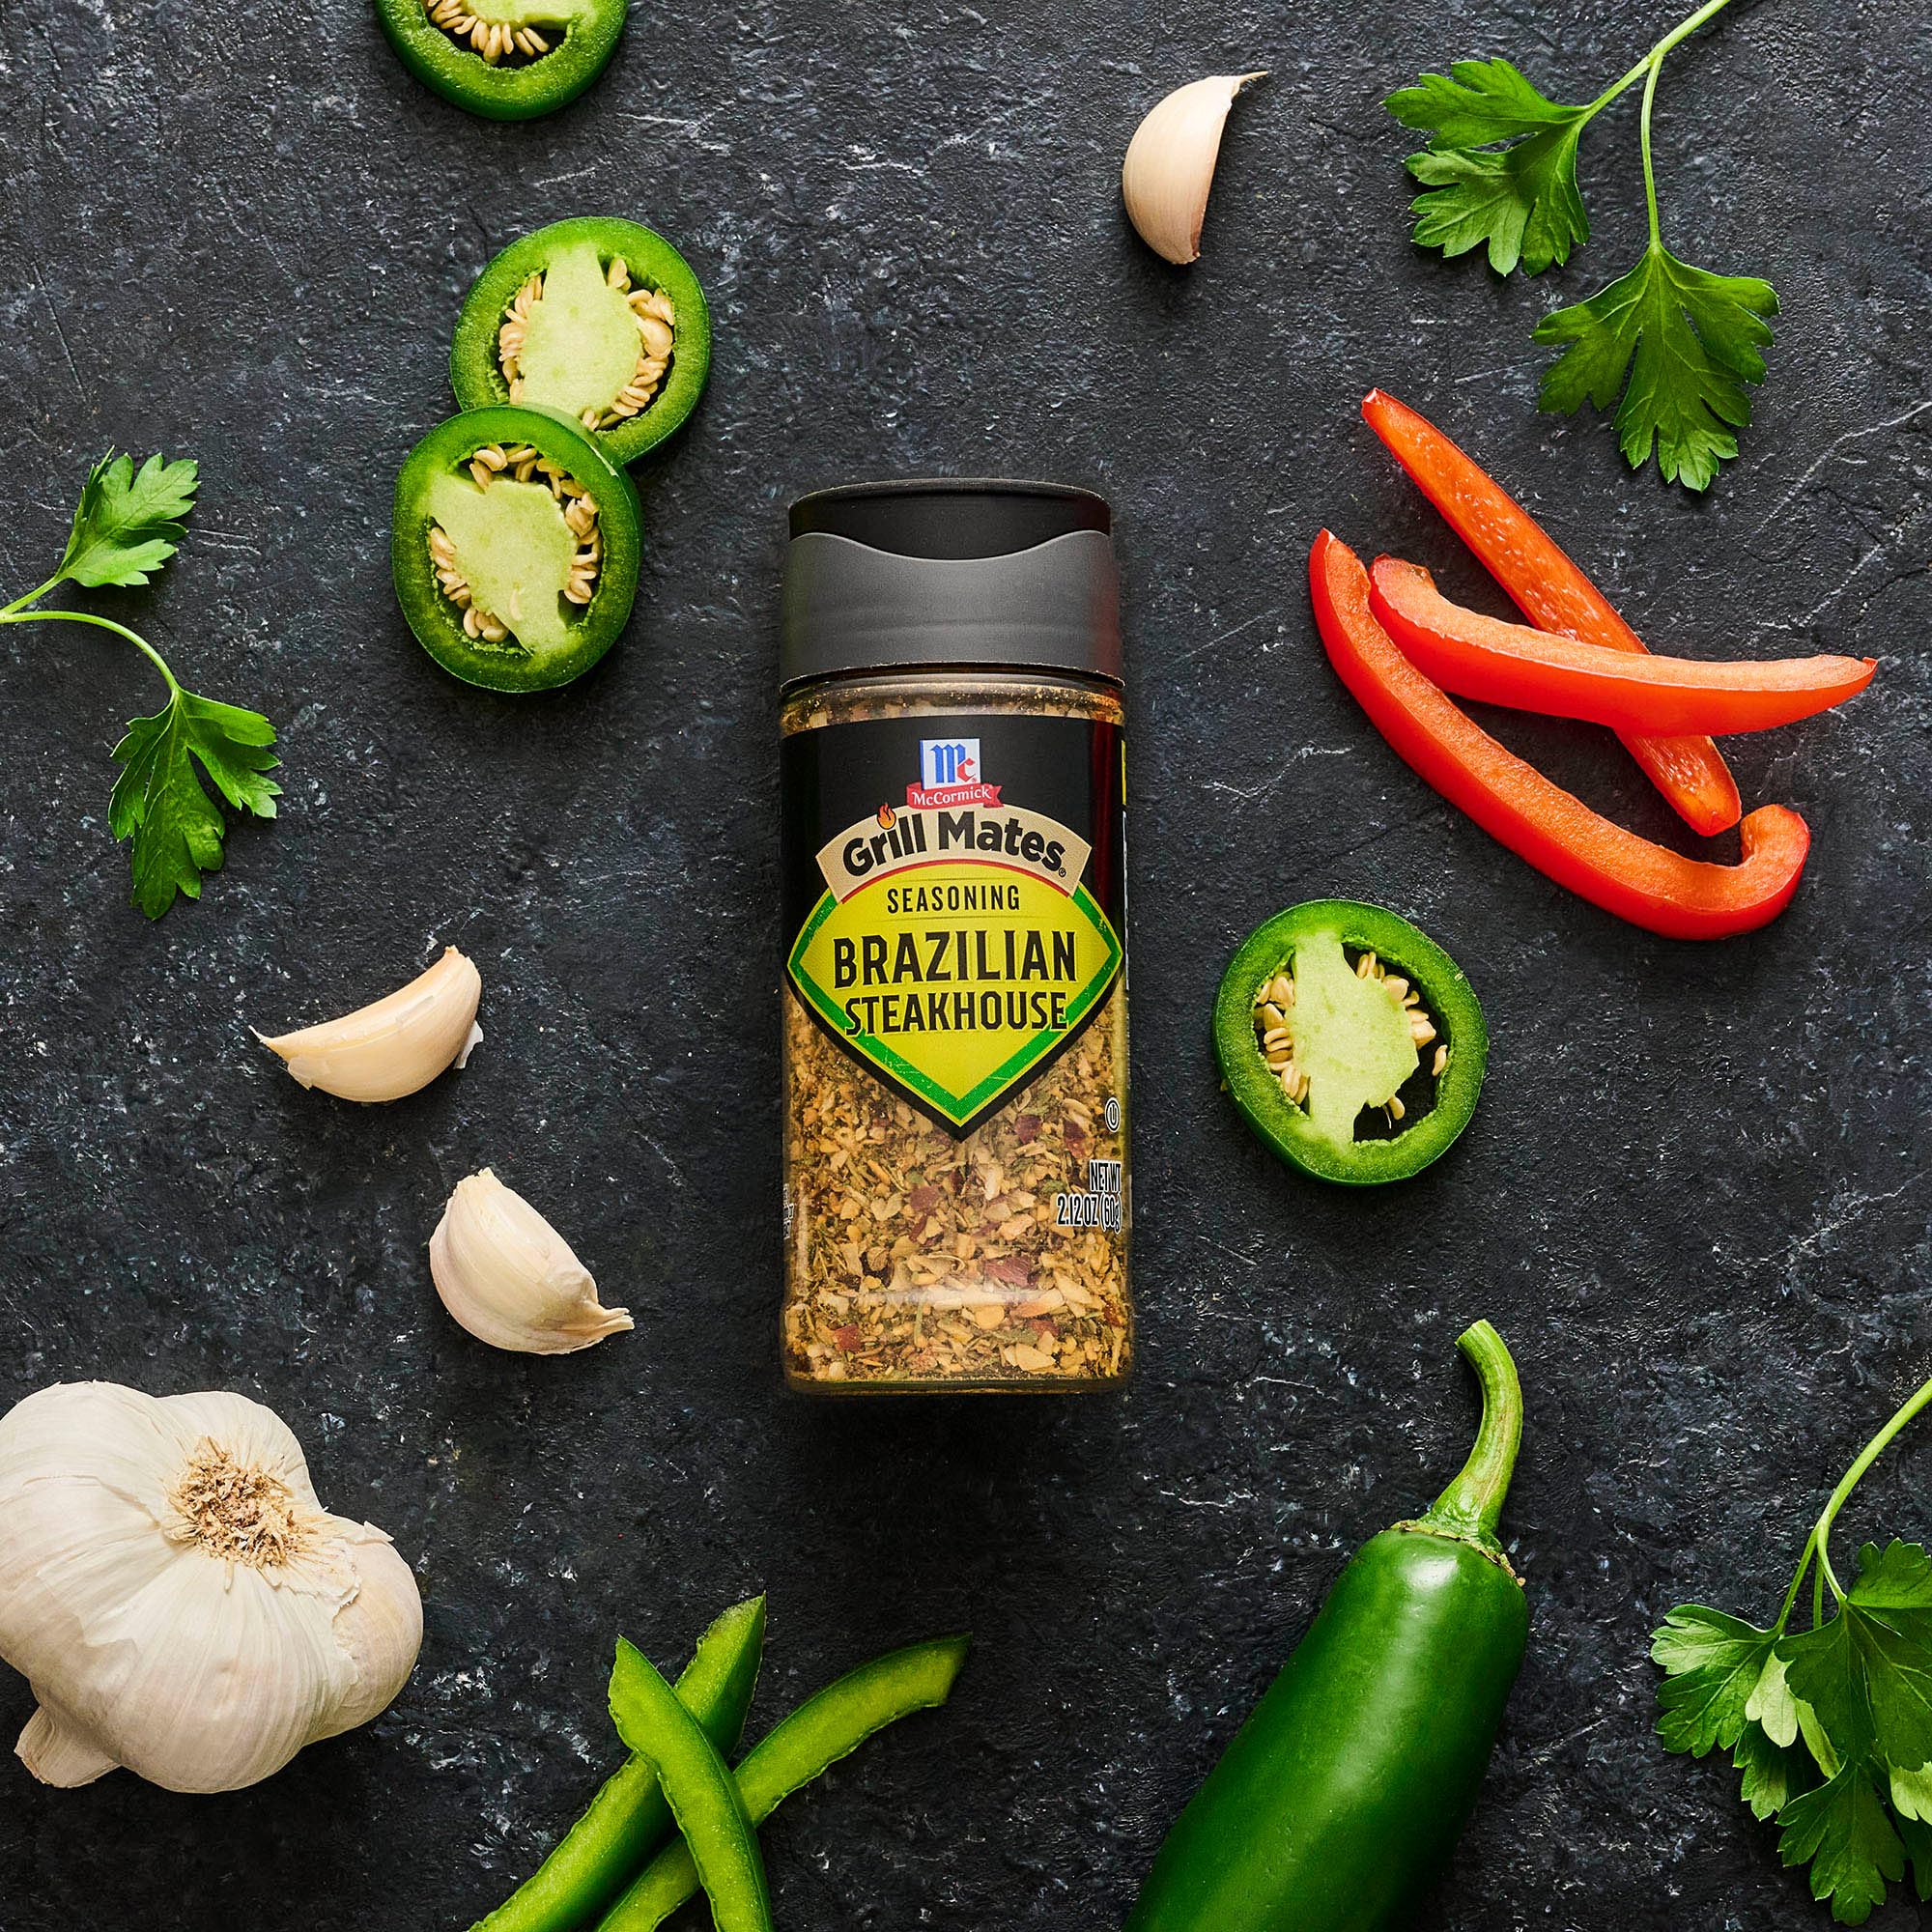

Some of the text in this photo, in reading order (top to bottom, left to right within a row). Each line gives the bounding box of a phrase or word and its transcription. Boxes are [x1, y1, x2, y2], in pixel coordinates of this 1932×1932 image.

[912, 785, 991, 806] McCormick
[842, 810, 1066, 876] Grill Mates
[887, 885, 1020, 914] SEASONING
[833, 929, 1077, 989] BRAZILIAN
[845, 990, 1068, 1036] STEAKHOUSE
[1090, 1161, 1122, 1192] NET WT
[1057, 1191, 1122, 1234] 2.12 OZ (60g)
